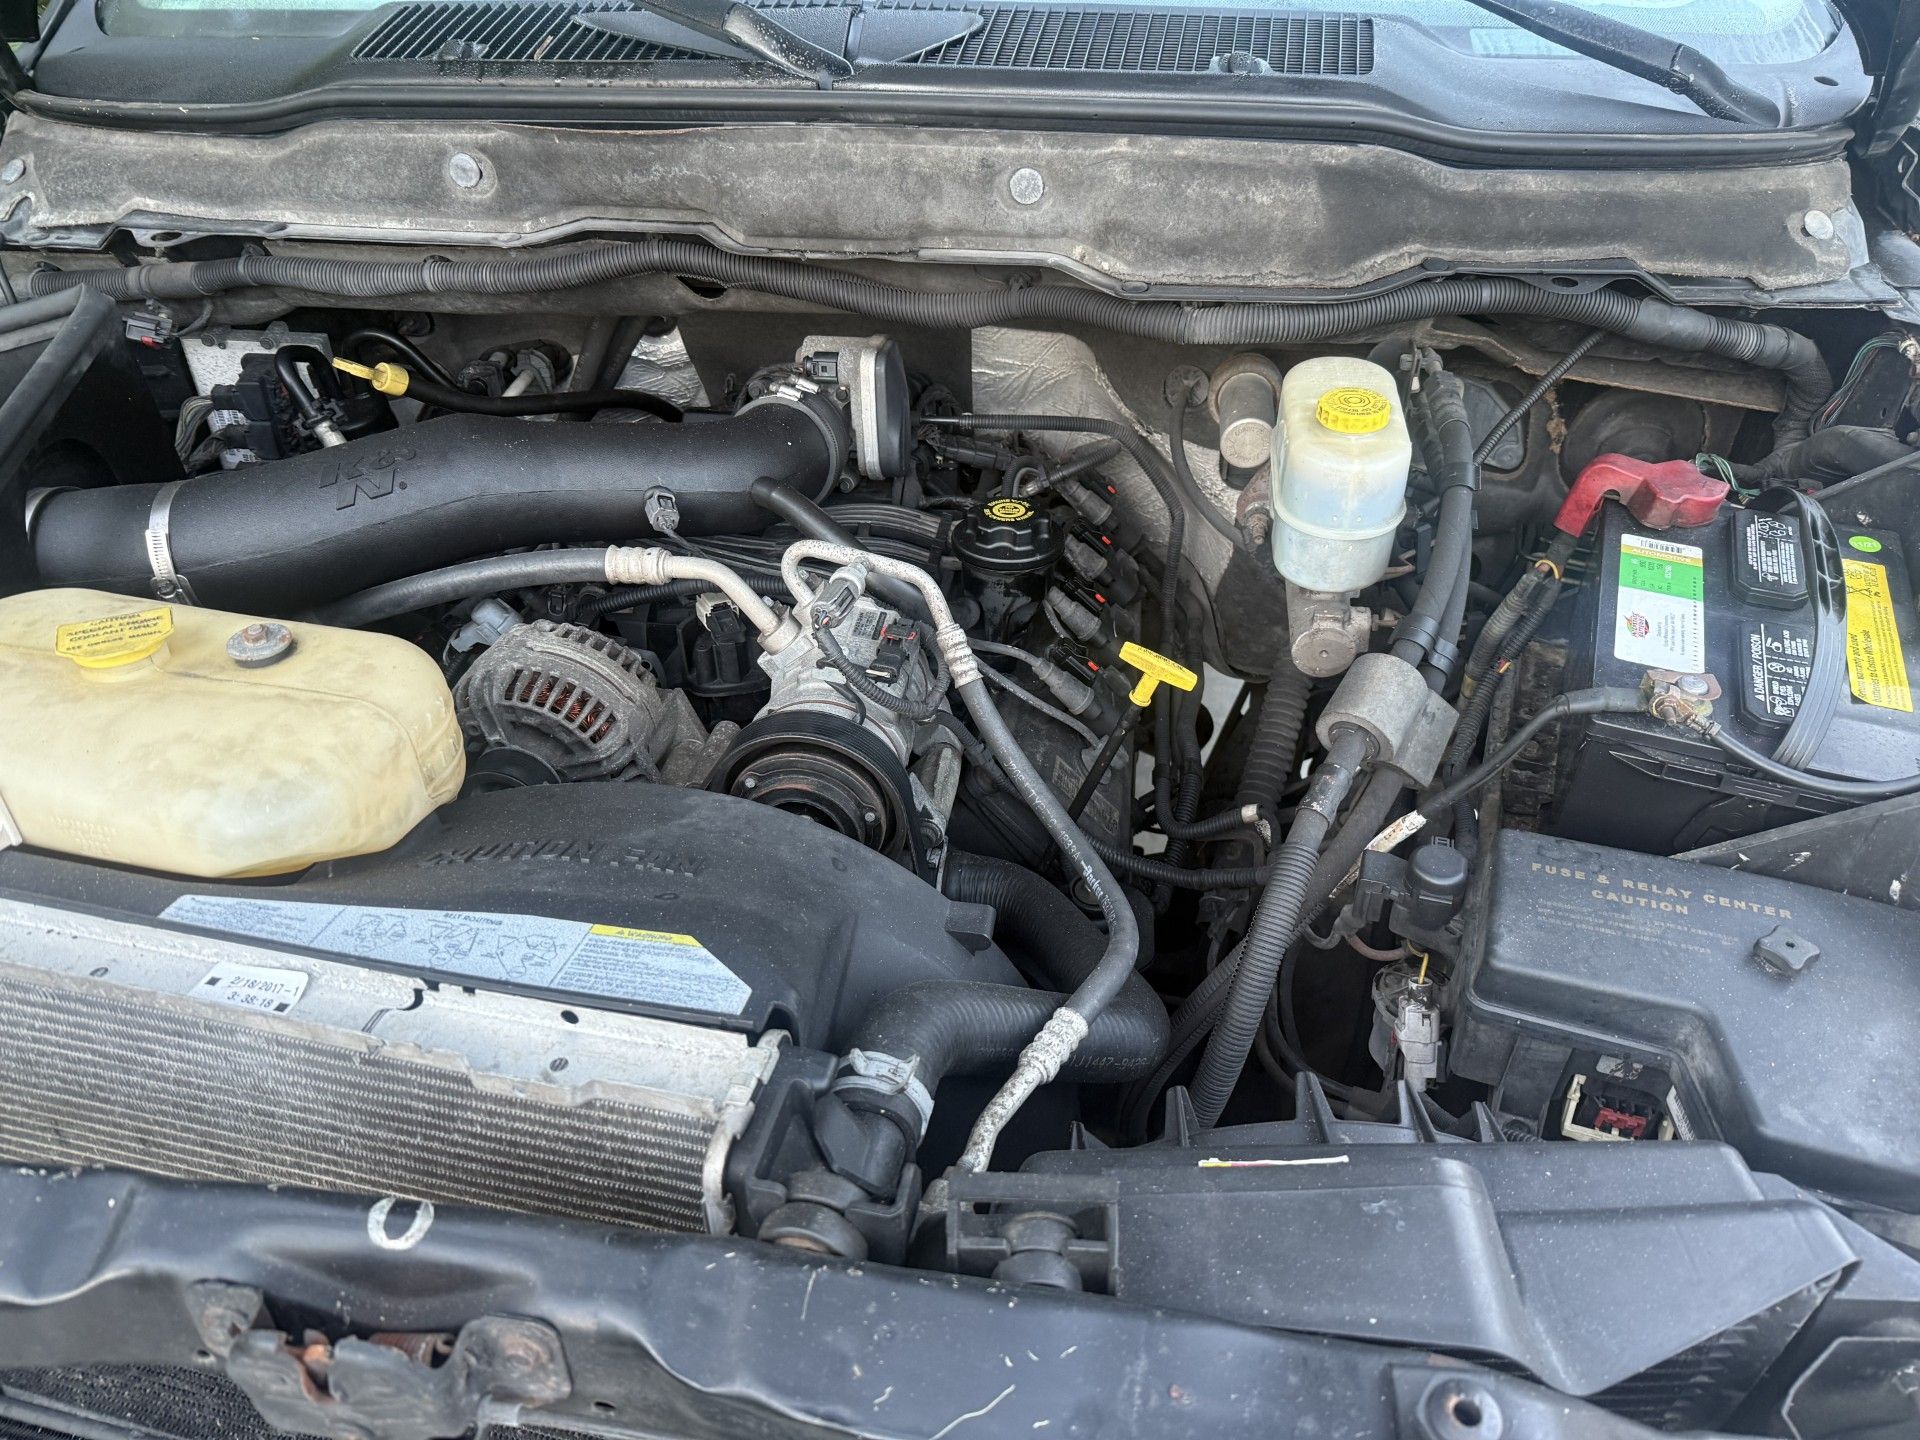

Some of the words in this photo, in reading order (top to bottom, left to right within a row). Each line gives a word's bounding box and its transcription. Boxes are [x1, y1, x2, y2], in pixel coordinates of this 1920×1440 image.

[1631, 547, 1692, 563] AUTOMOTIVE
[65, 624, 115, 637] SPECIAL
[68, 628, 125, 642] COOLANT
[128, 621, 159, 631] ONLY
[1848, 632, 1858, 647] used
[1862, 629, 1874, 655] Wholesale
[1750, 633, 1762, 660] POISON
[1850, 647, 1860, 657] and
[1853, 657, 1865, 680] warranty
[1867, 656, 1877, 672] Costco
[1752, 664, 1765, 694] DANGER
[1870, 679, 1882, 703] batteries
[1531, 862, 1587, 881] FUSE
[1596, 874, 1611, 885] &
[1622, 879, 1693, 900] RELAY
[1703, 893, 1793, 920] CENTER
[1591, 889, 1689, 915] CAUTION
